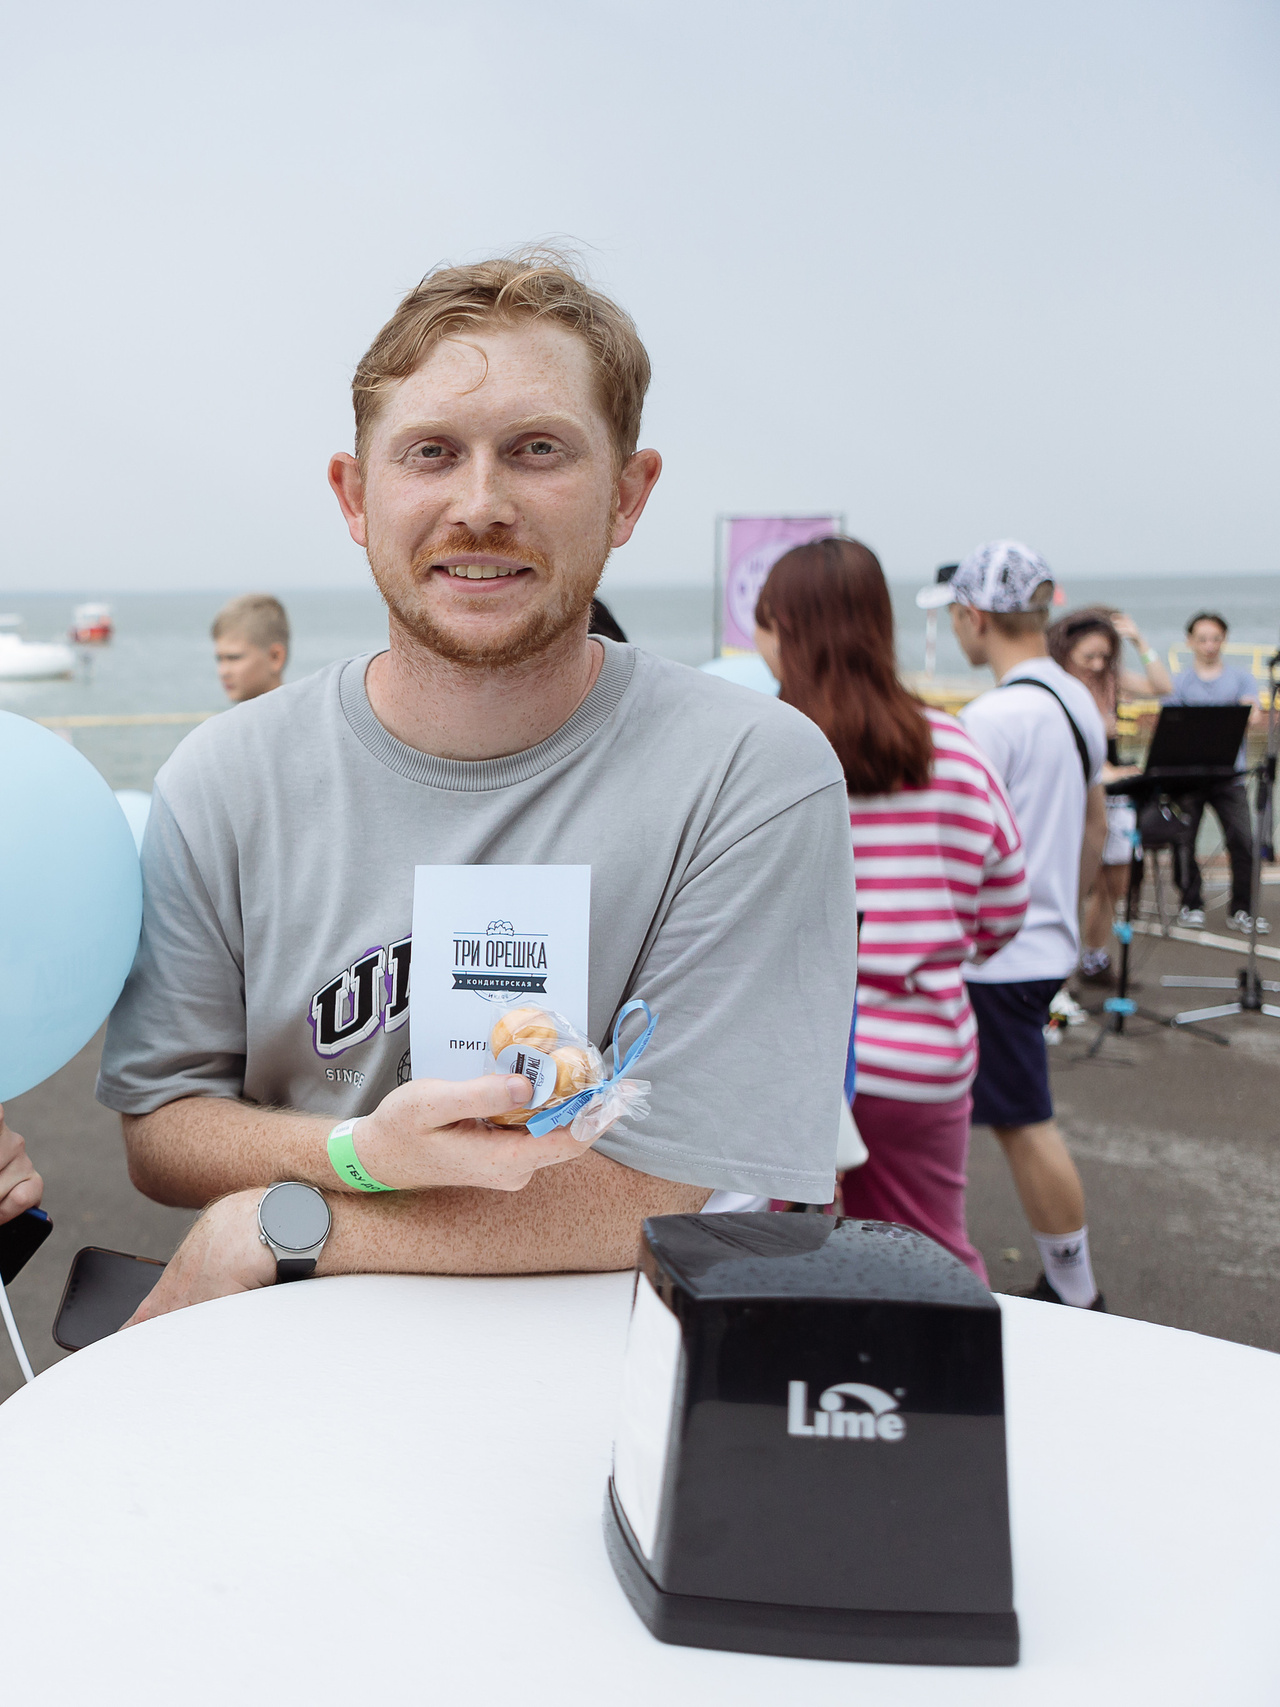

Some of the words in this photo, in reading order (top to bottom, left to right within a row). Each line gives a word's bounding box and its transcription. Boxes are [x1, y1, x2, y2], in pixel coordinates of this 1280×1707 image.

[452, 939, 481, 967] ТРИ
[485, 940, 548, 970] ОРЕШКА
[466, 978, 533, 988] КОНДИТЕРСКАЯ
[325, 1067, 366, 1089] SINCE
[346, 1164, 366, 1182] ГБУ
[787, 1380, 907, 1442] Lime
